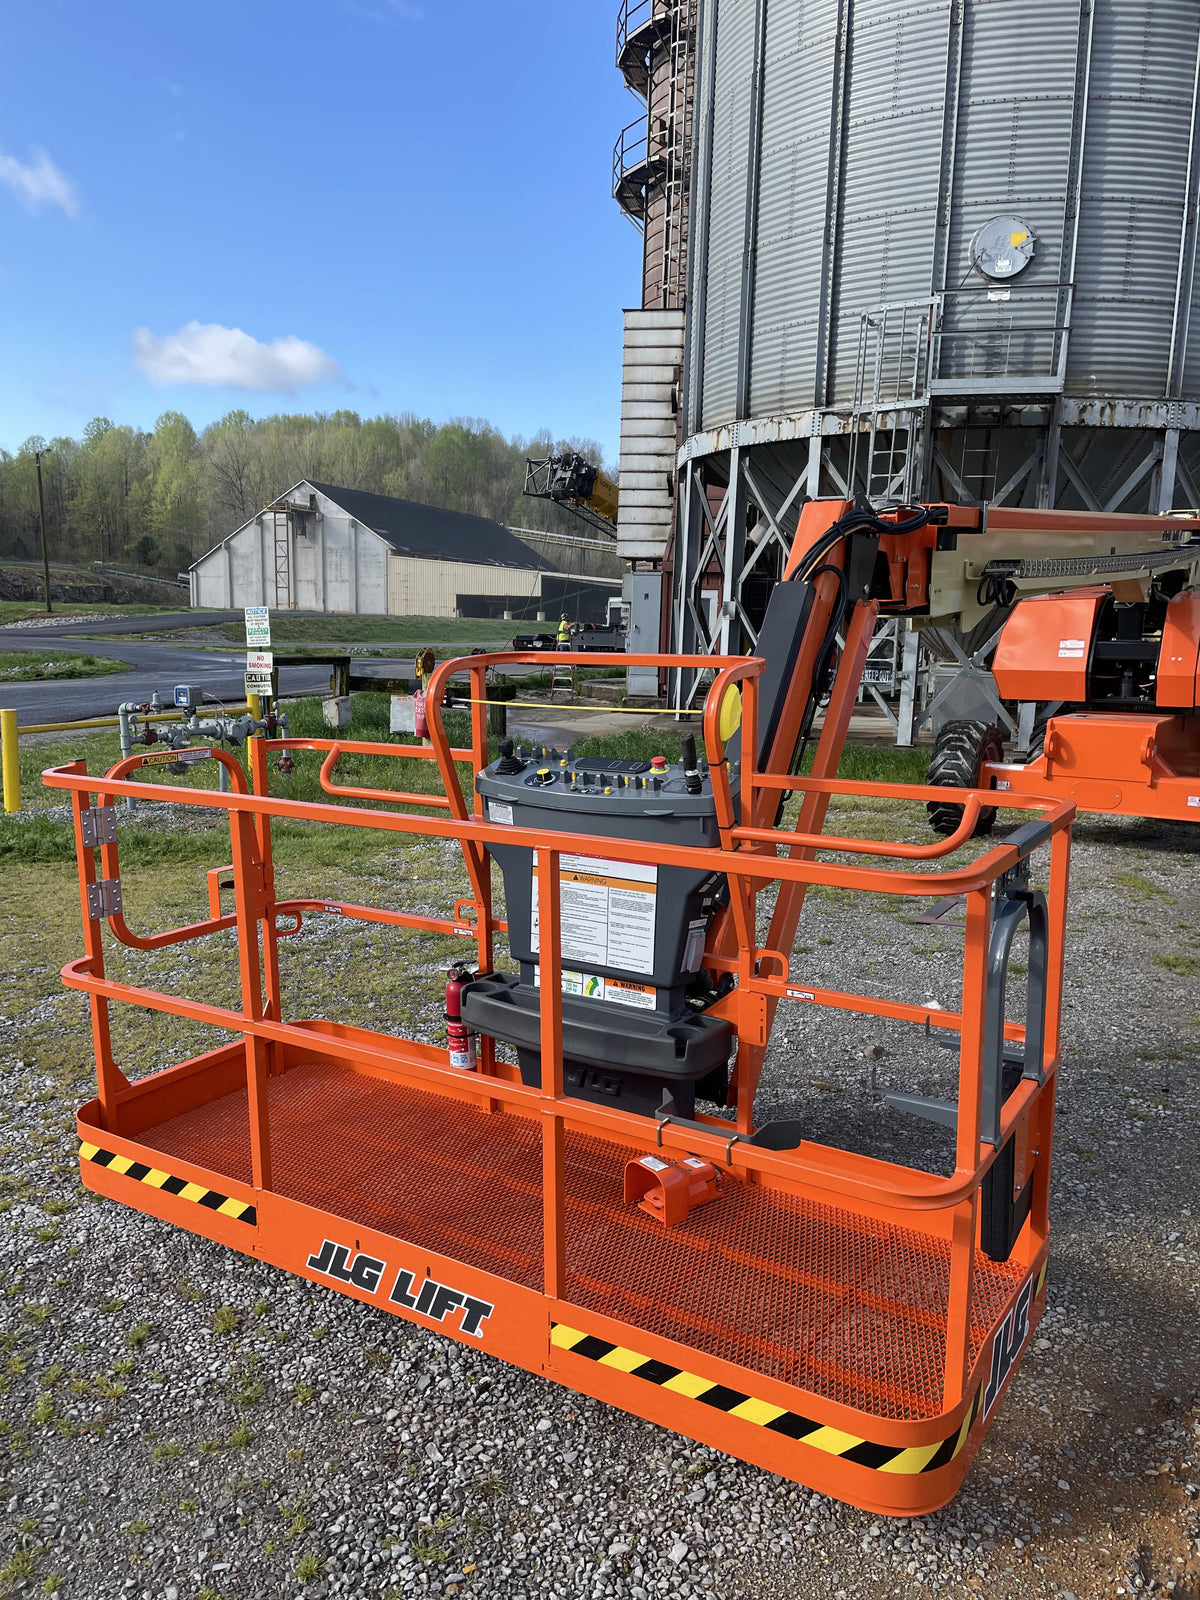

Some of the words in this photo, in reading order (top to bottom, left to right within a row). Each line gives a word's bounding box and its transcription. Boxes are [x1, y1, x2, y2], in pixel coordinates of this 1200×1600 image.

[148, 755, 177, 764] CAUTION
[579, 875, 607, 885] WARNING
[620, 981, 646, 992] WARNING
[568, 1066, 620, 1097] JLG
[306, 1238, 387, 1294] JLG
[982, 1272, 1034, 1424] JLG
